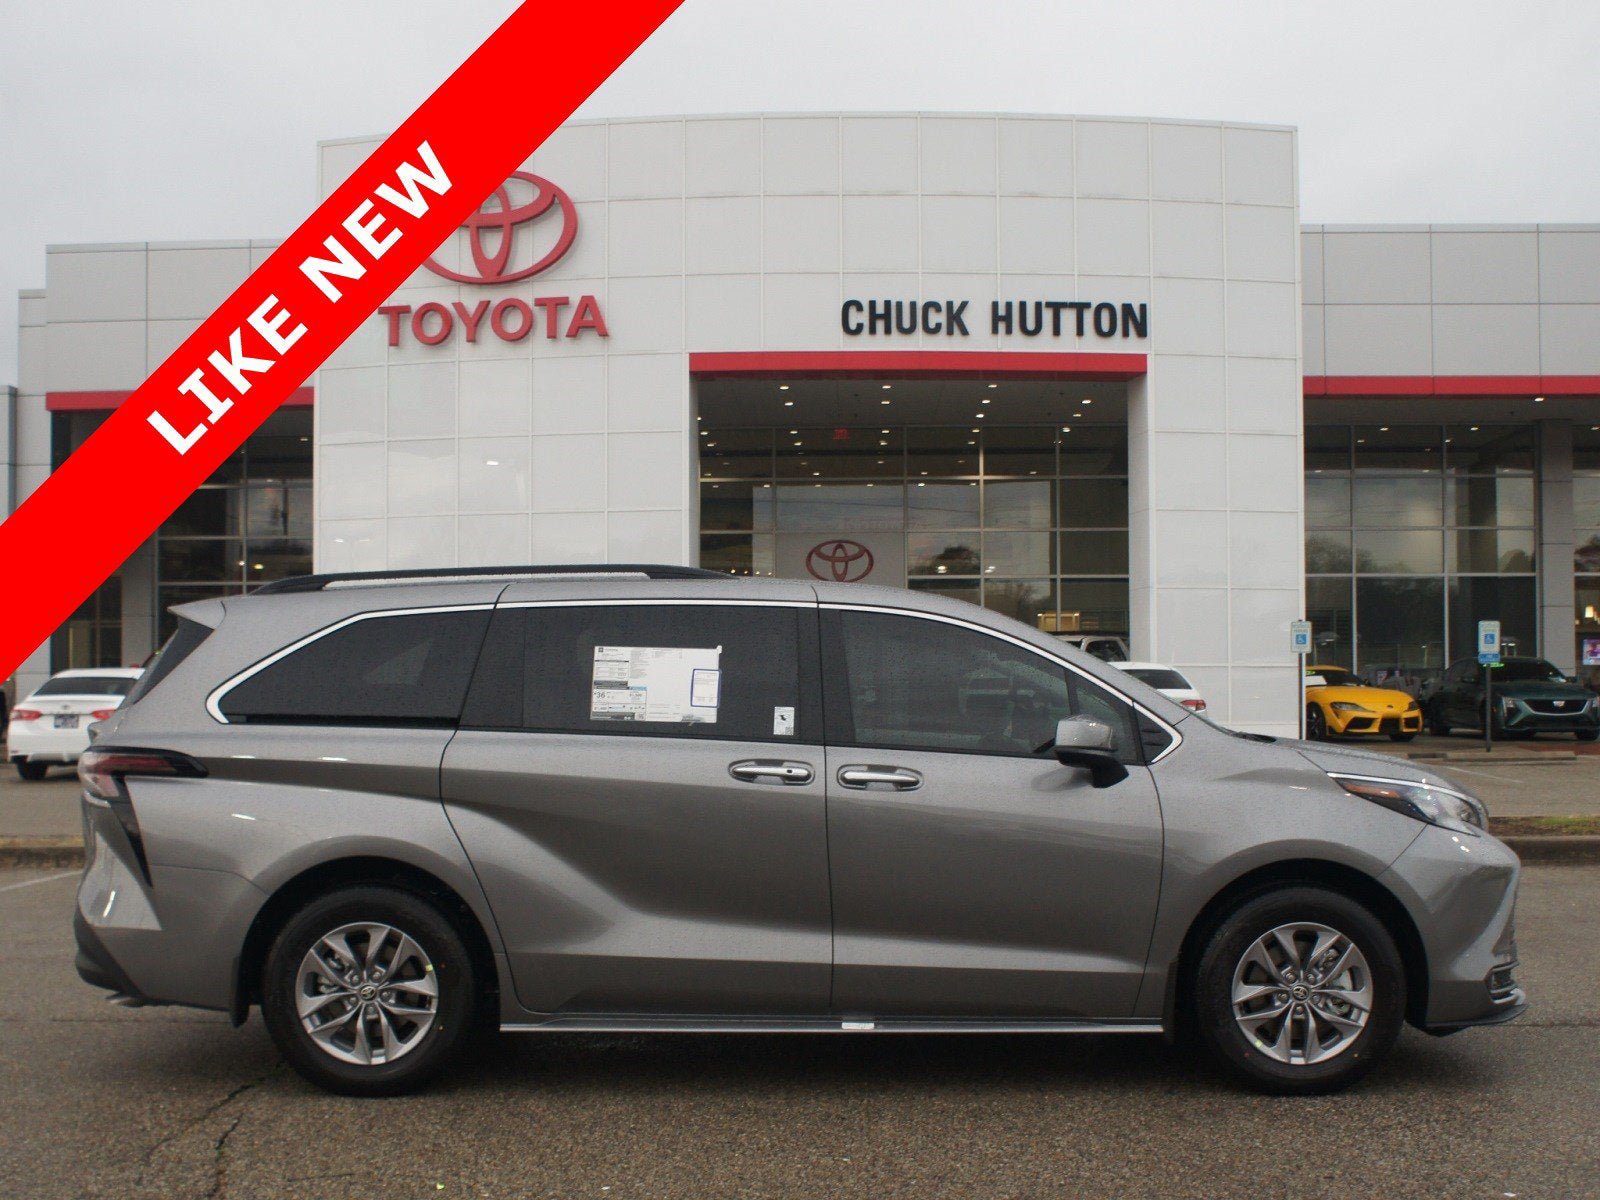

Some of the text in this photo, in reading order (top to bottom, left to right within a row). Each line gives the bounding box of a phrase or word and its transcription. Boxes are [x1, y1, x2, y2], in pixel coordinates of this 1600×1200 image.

[378, 295, 609, 347] TOYOTA
[841, 299, 1148, 338] CHUCK HUTTON
